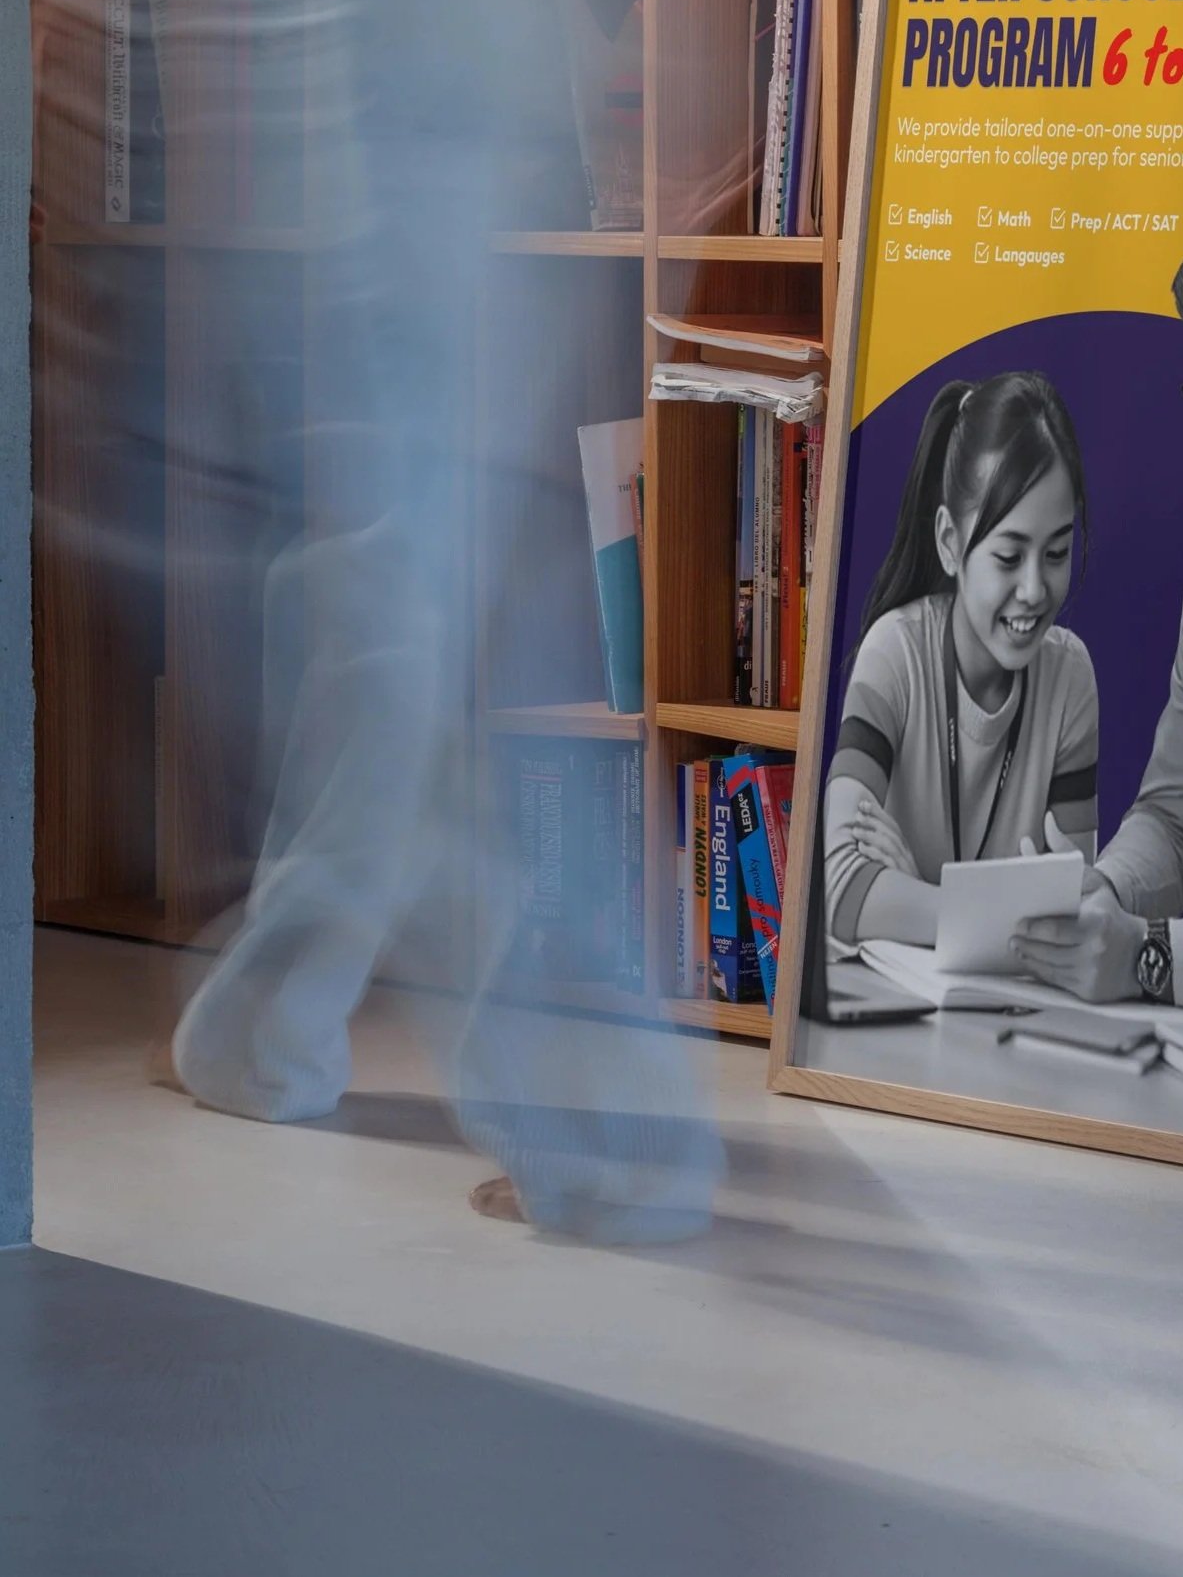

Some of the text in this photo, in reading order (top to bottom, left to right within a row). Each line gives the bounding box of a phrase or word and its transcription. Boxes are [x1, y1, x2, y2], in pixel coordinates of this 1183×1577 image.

[902, 17, 1095, 88] PROGRAM
[1103, 28, 1130, 86] 6
[897, 118, 922, 137] We
[924, 119, 981, 141] provide
[984, 117, 1044, 139] tailored
[1047, 123, 1141, 140] one-on-one
[895, 146, 991, 171] kindergarten
[994, 148, 1010, 165] to
[1013, 146, 1068, 171] college
[1072, 150, 1108, 171] prep
[1112, 147, 1135, 166] for
[907, 208, 1179, 234] English Math Prep ACT SAT
[904, 243, 1065, 267] Science Langauges
[712, 804, 731, 912] England
[748, 858, 774, 938] pro samouky
